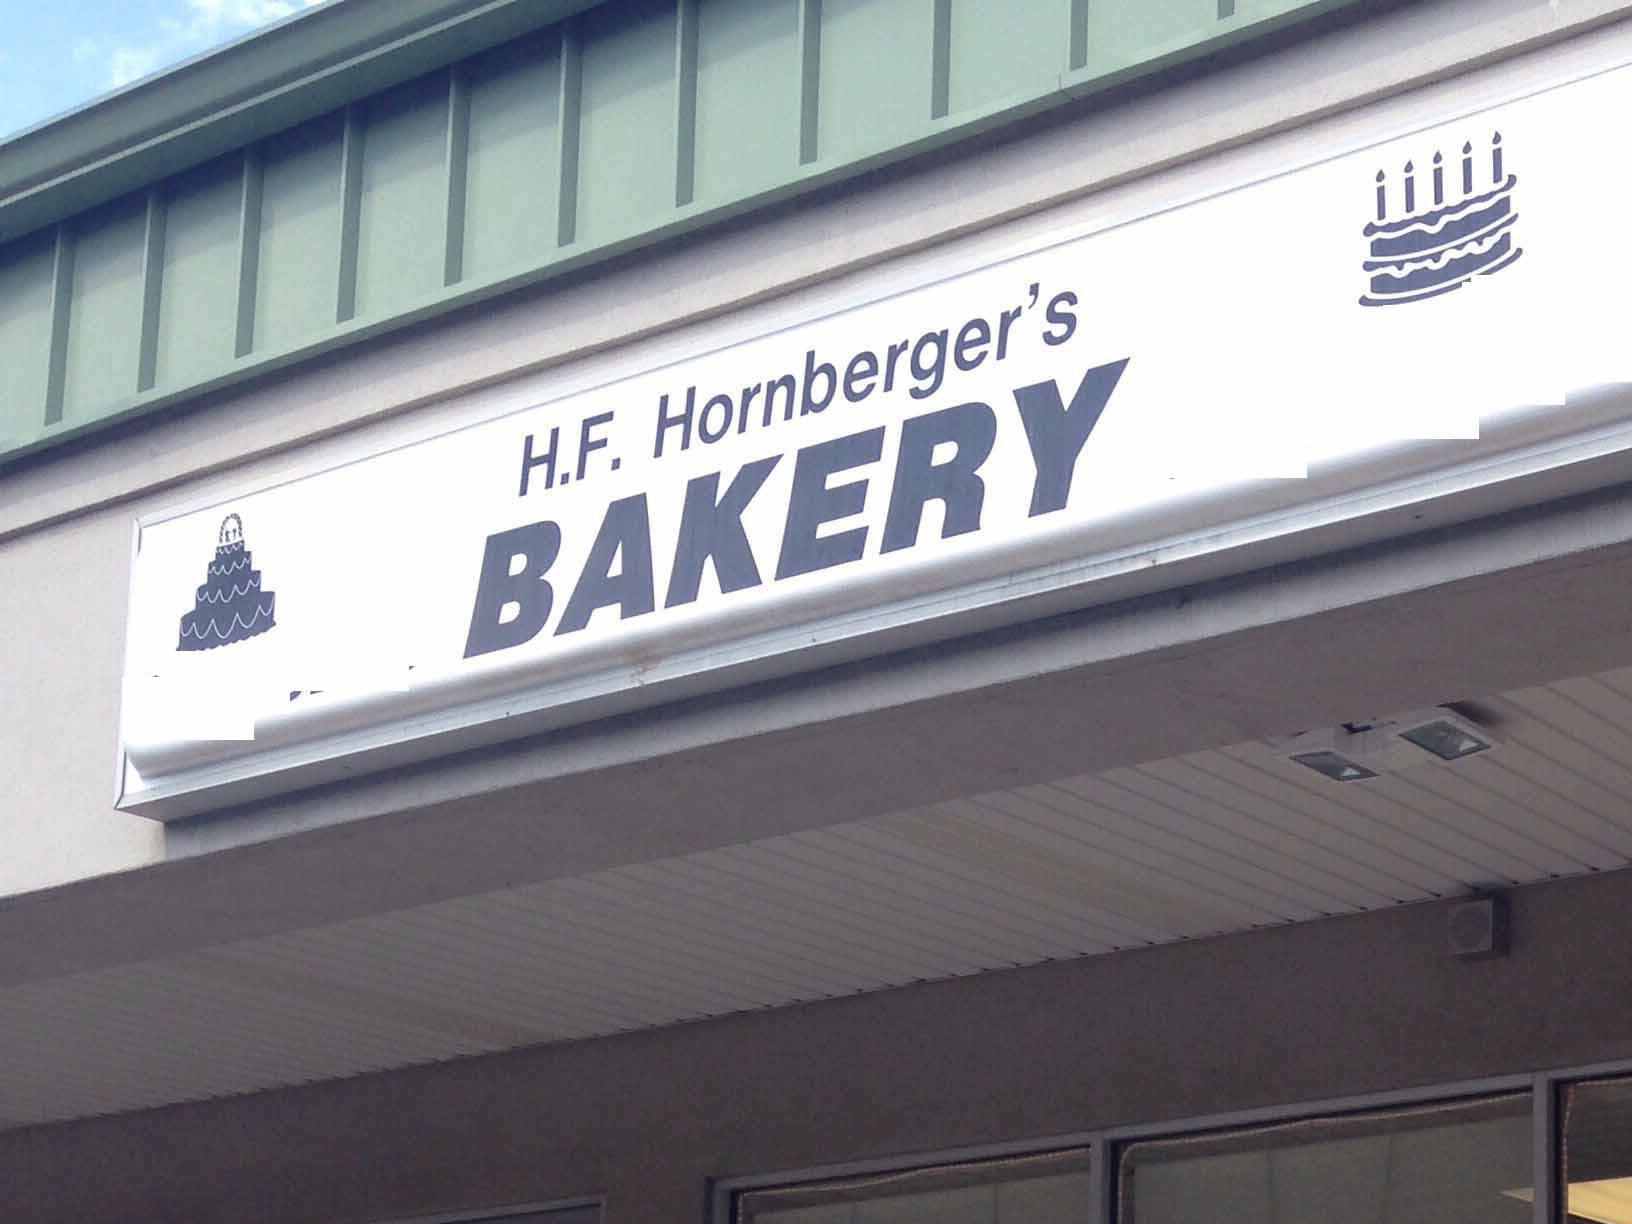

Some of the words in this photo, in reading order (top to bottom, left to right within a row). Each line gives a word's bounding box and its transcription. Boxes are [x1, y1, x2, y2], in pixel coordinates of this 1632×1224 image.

[462, 357, 1131, 659] BAKERY
[518, 411, 622, 497] H.F.
[653, 283, 1078, 458] Hornberger's
